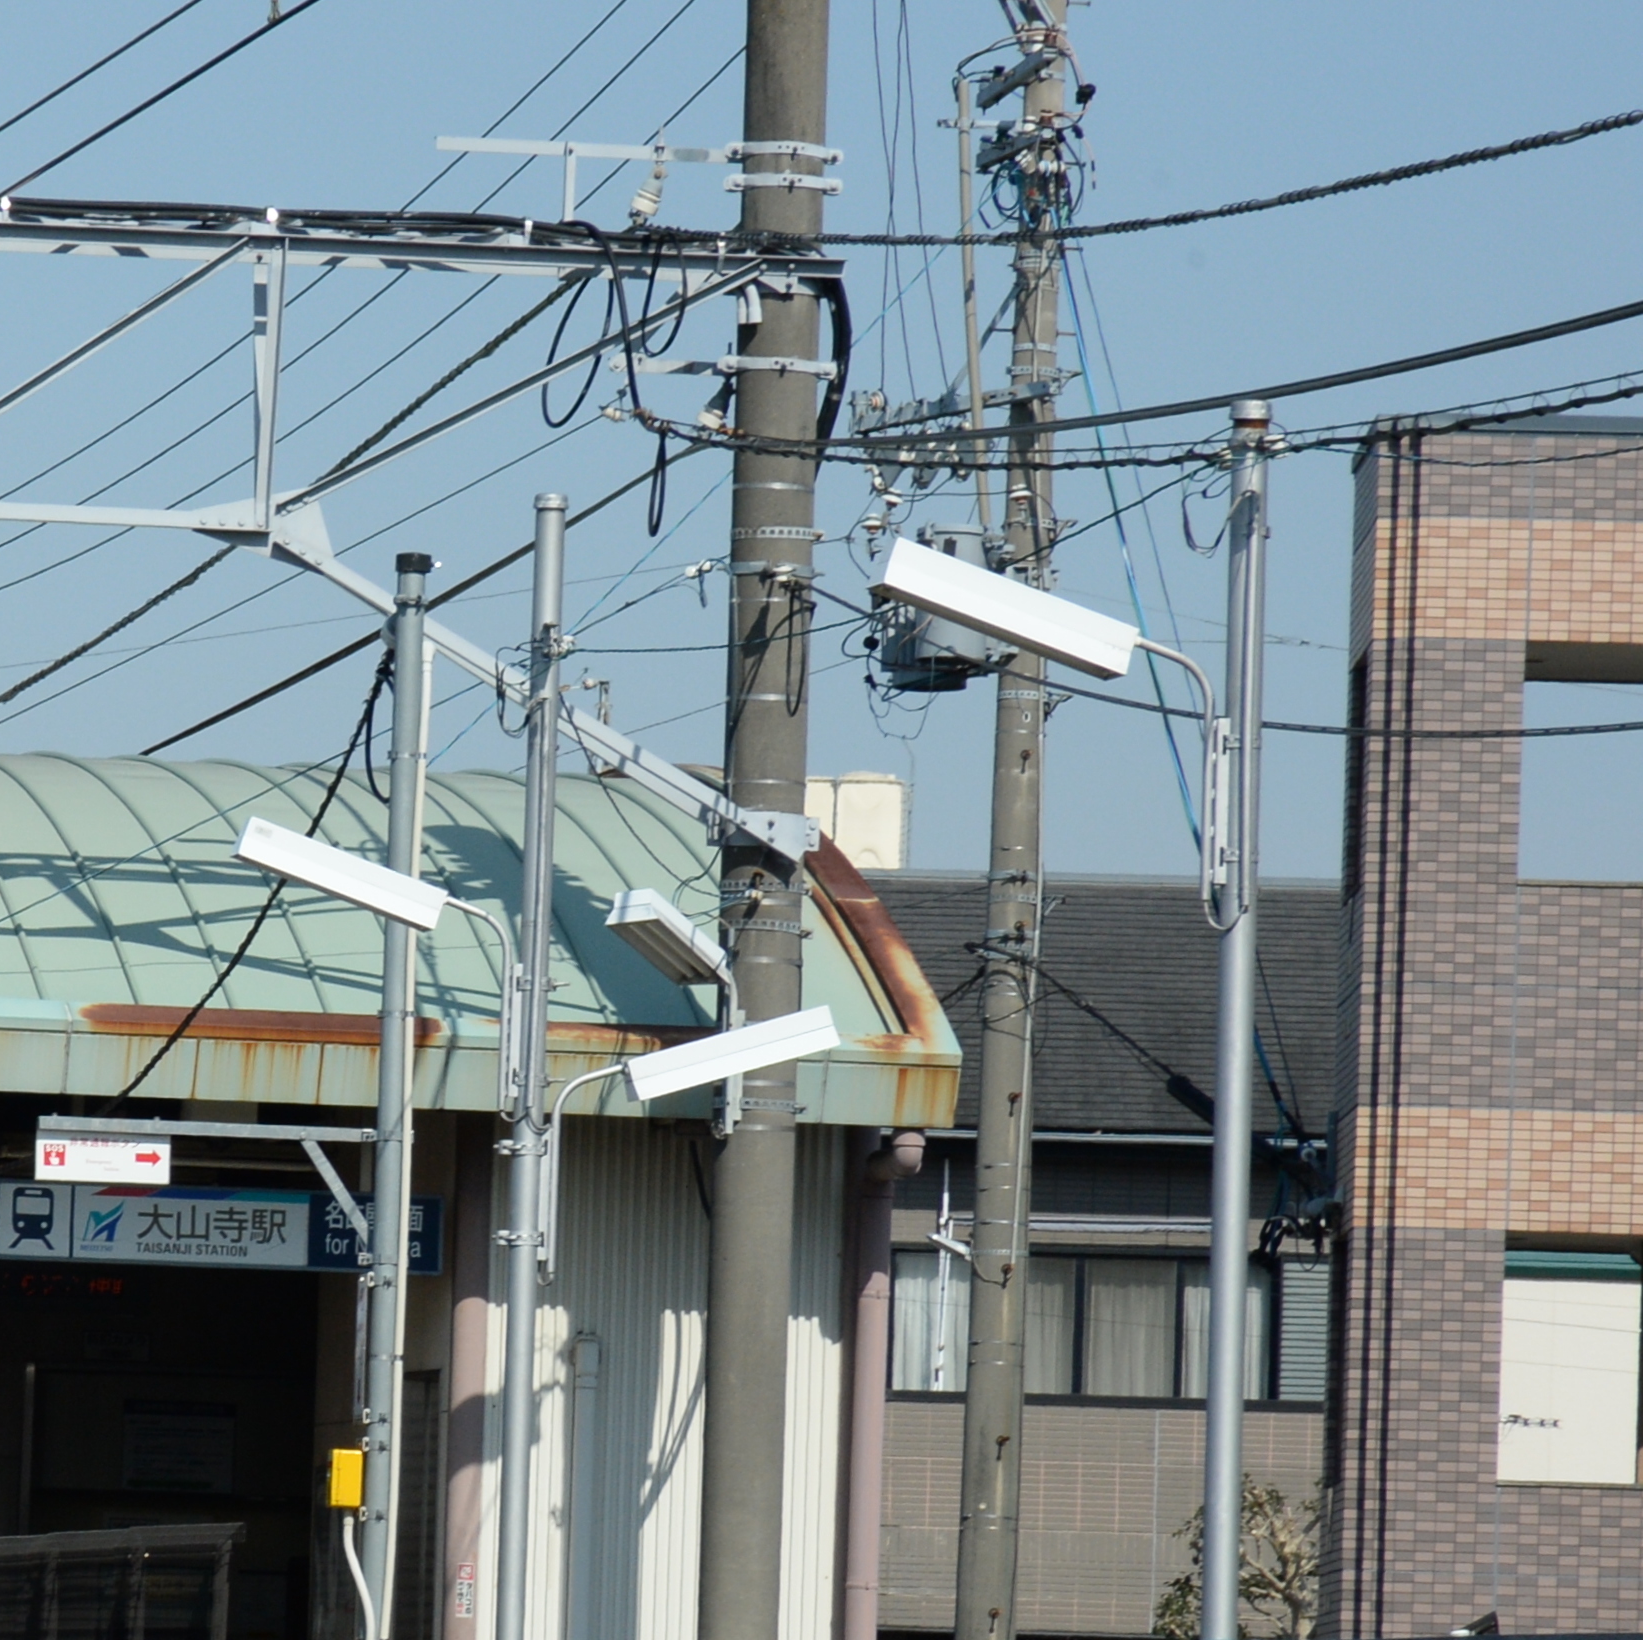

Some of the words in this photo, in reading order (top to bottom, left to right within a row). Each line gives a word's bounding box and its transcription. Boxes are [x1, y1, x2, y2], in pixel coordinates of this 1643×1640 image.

[137, 1203, 287, 1245] 大山寺駅
[135, 1242, 192, 1256] TAISANJI
[195, 1243, 248, 1257] STATION
[325, 1234, 350, 1255] for
